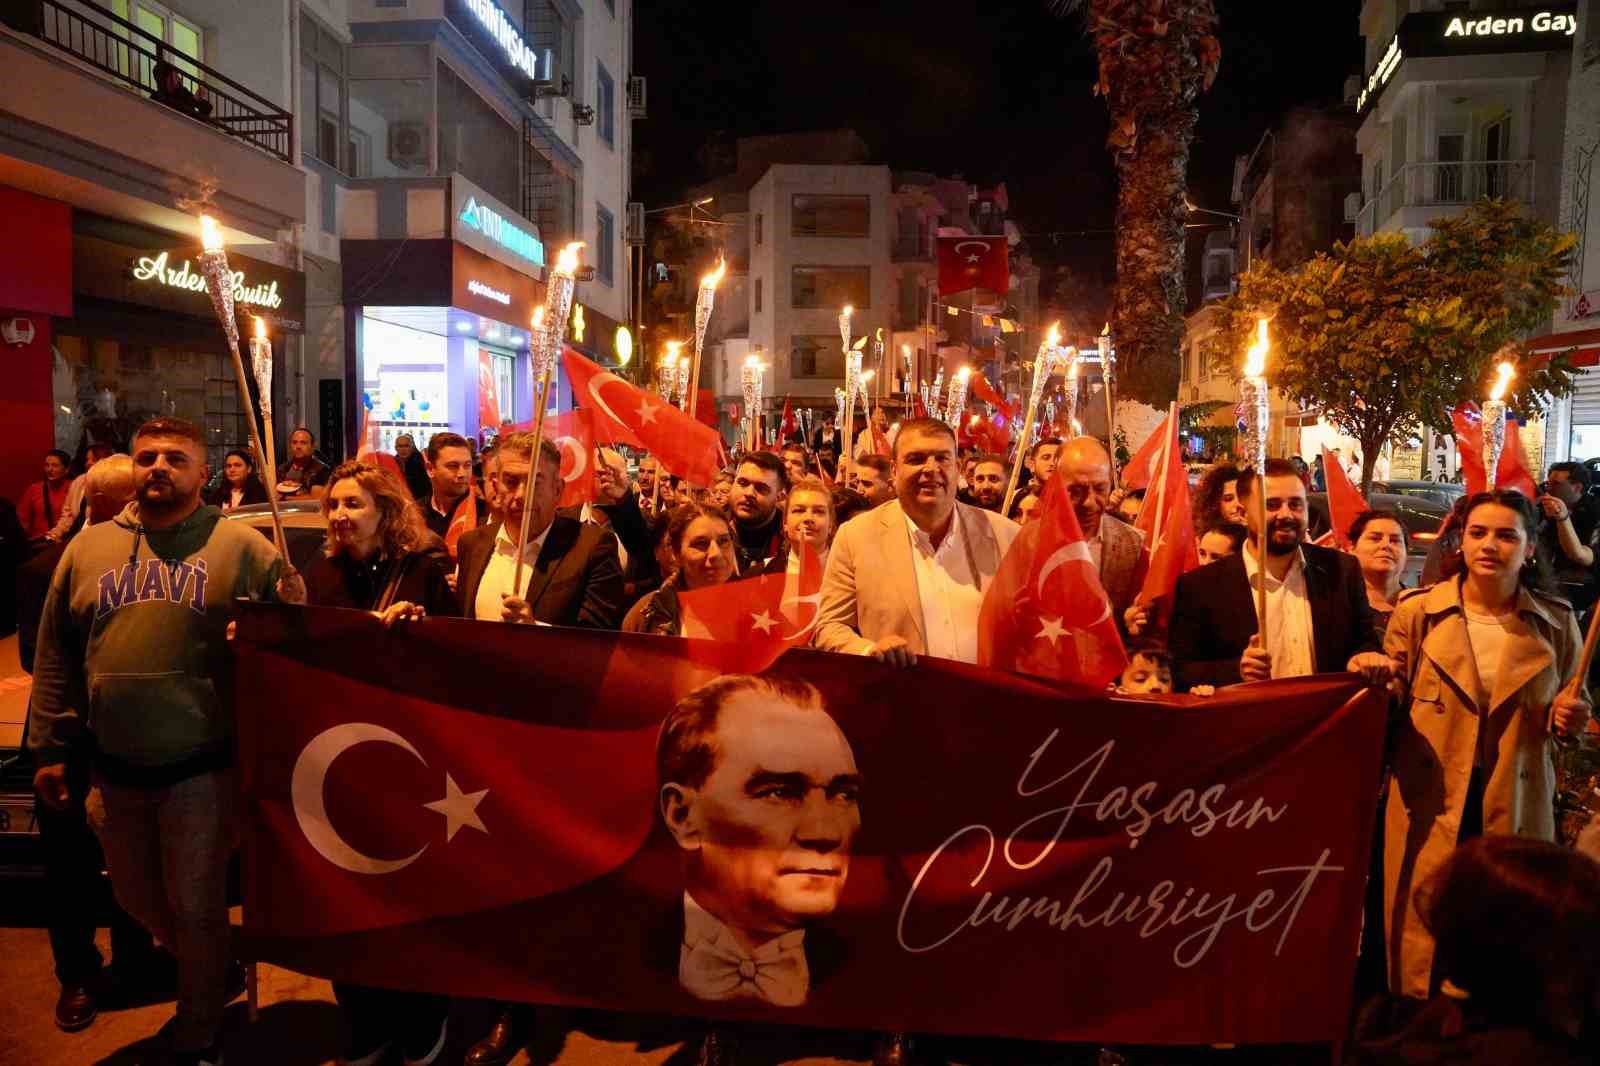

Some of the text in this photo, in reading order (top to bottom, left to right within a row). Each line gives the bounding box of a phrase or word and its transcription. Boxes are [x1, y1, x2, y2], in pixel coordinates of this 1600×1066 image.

[1444, 11, 1577, 37] Arden Gay
[133, 251, 281, 309] Arden Butik
[95, 557, 209, 619] MAVİ
[1003, 727, 1288, 870] Yaşasın
[897, 847, 1345, 969] Cumhuriyet
